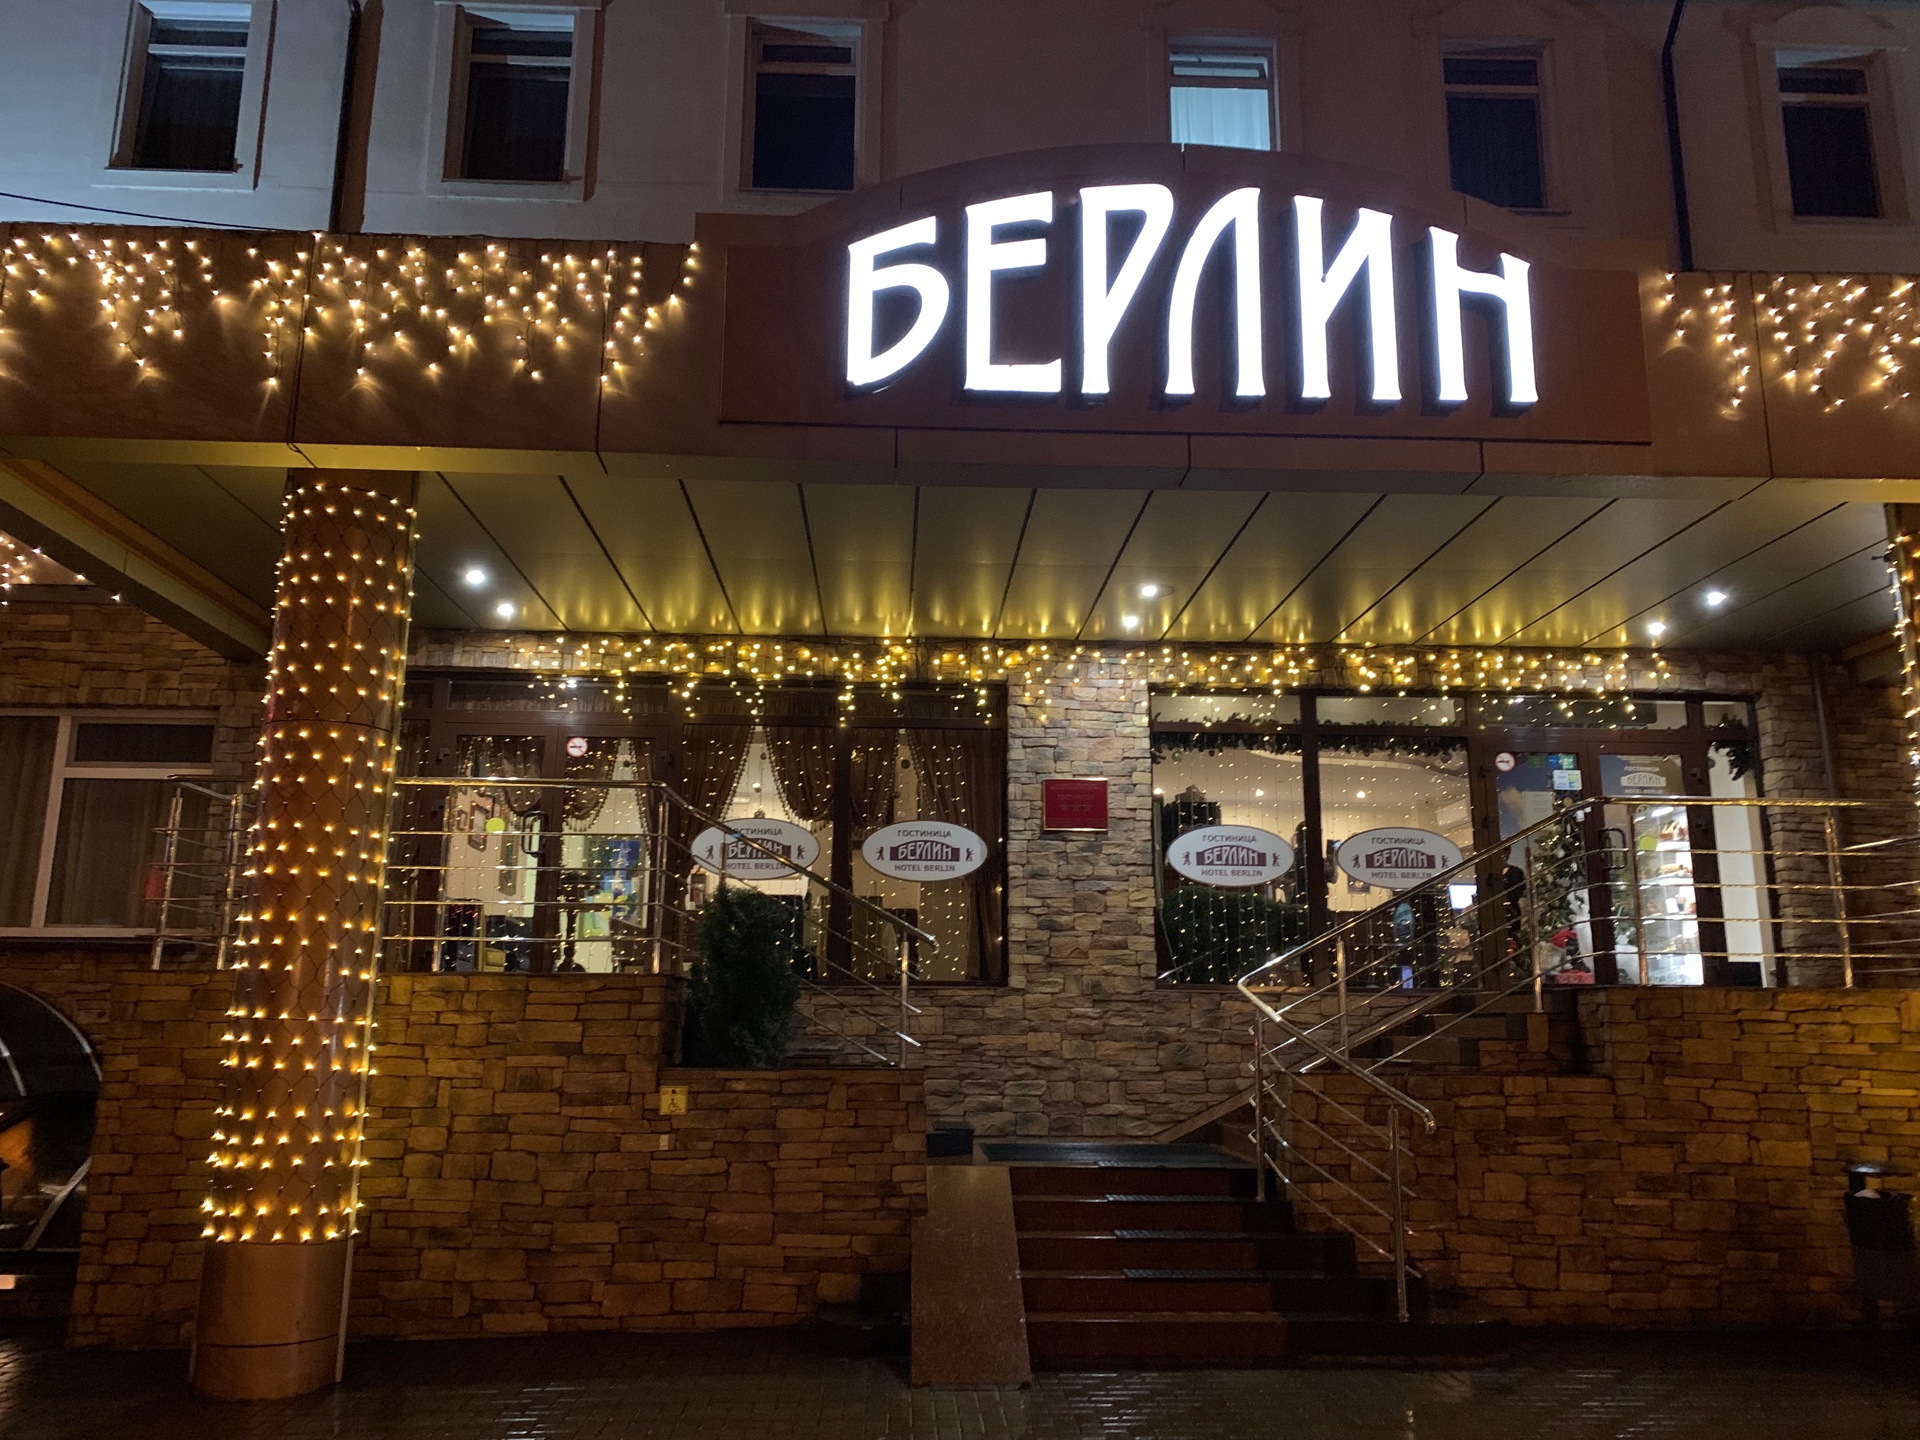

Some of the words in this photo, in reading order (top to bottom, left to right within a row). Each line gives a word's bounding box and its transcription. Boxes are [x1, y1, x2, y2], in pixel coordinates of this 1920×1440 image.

[847, 183, 1538, 402] БЕРЛИН
[897, 829, 952, 838] ГОСТИНИЦА
[1202, 834, 1257, 843] ГОСТИНИЦА
[1371, 837, 1426, 846] ГОСТИНИЦА
[898, 841, 952, 860] БЕРЛИН
[1204, 846, 1259, 865] БЕРЛИН
[1373, 848, 1428, 867] БЕРЛИН
[894, 864, 922, 872] HOTEL
[924, 864, 956, 872] BERLIN
[1201, 869, 1229, 877] HOTEL
[1231, 869, 1263, 877] BERLIN
